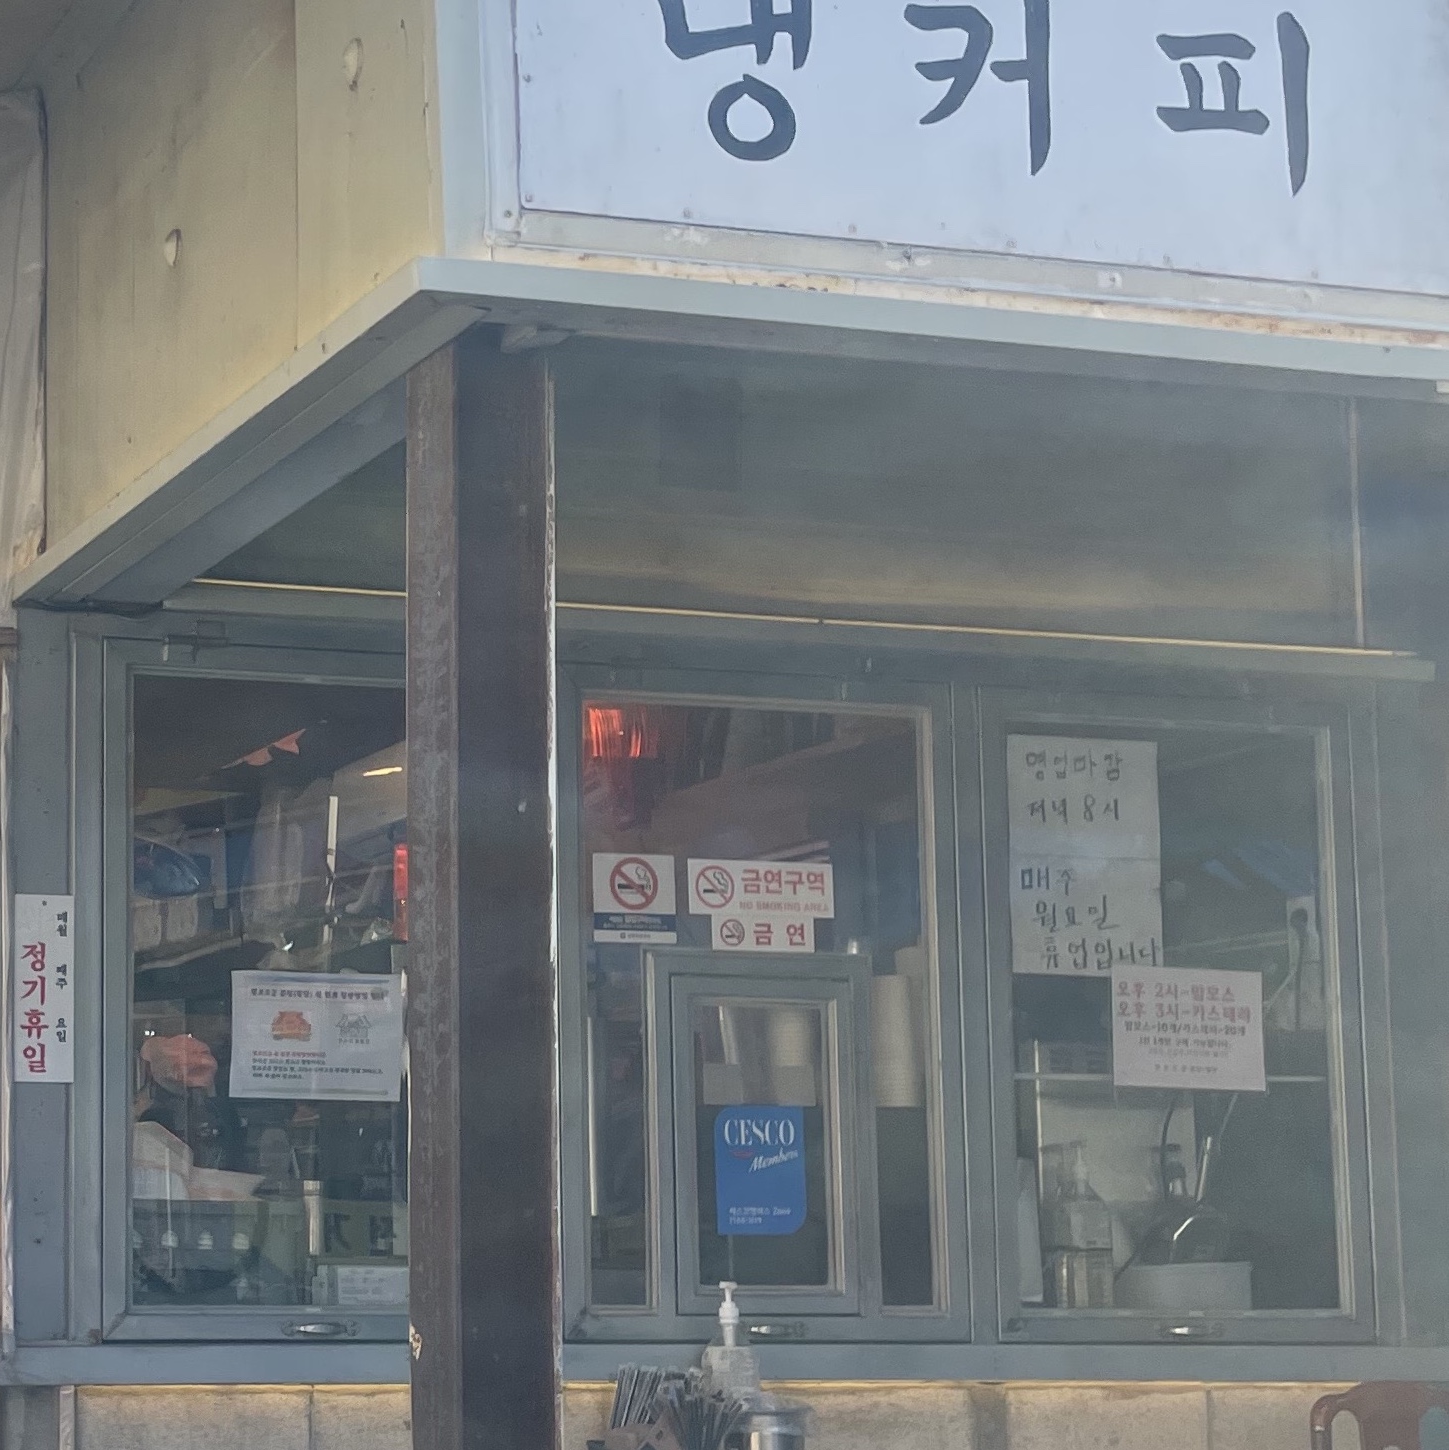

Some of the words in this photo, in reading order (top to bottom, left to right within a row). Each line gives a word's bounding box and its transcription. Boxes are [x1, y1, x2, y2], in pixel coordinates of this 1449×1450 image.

[1026, 798, 1069, 826] 저녁
[1082, 794, 1120, 822] 8시
[741, 867, 826, 897] 금연구역
[1020, 866, 1076, 897] 매주
[739, 901, 753, 910] NO
[756, 902, 800, 912] SMOKING
[804, 903, 830, 913] AREA
[1034, 894, 1121, 933] 월요일
[1040, 935, 1159, 970] 휴업입니다
[1117, 980, 1146, 999] 오후
[20, 940, 50, 1074] 정기휴일
[1117, 1001, 1147, 1019] 오후
[56, 1016, 68, 1043] 요일
[724, 1119, 795, 1146] CESCO
